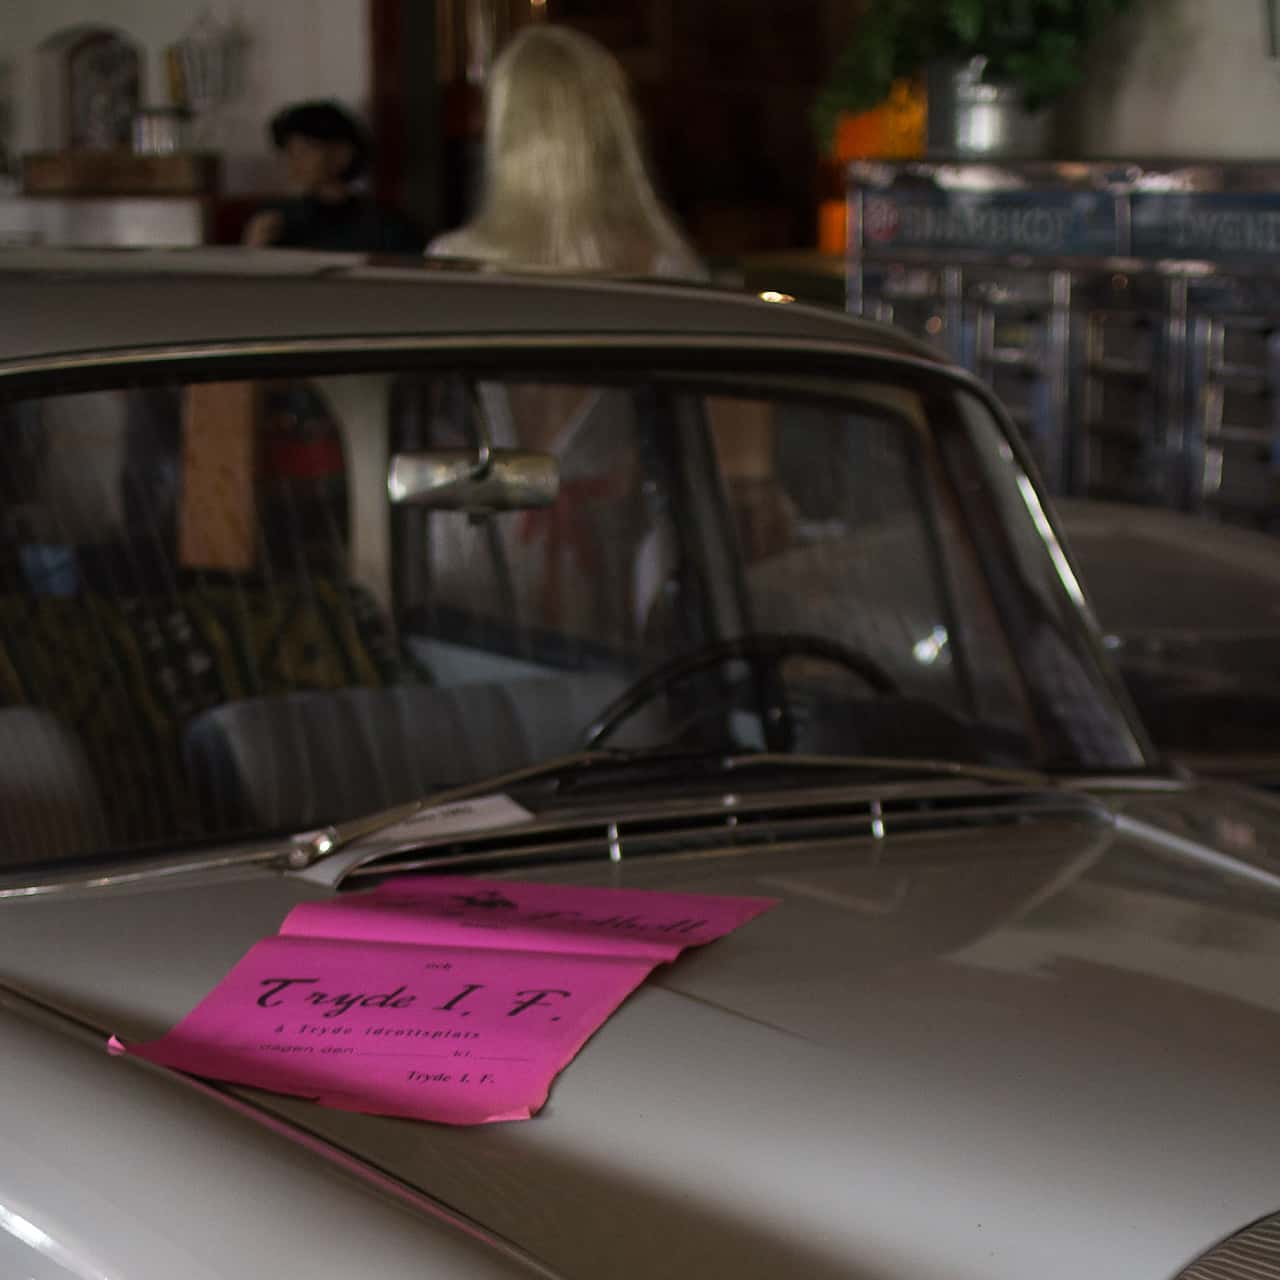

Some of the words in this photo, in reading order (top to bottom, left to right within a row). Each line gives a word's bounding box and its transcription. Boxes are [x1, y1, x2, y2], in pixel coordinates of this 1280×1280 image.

[256, 977, 417, 1018] Tryde
[432, 983, 486, 1017] I.
[506, 988, 573, 1023] F.
[406, 1069, 452, 1084] Tryde
[458, 1071, 472, 1084] I.
[479, 1073, 496, 1085] F.
